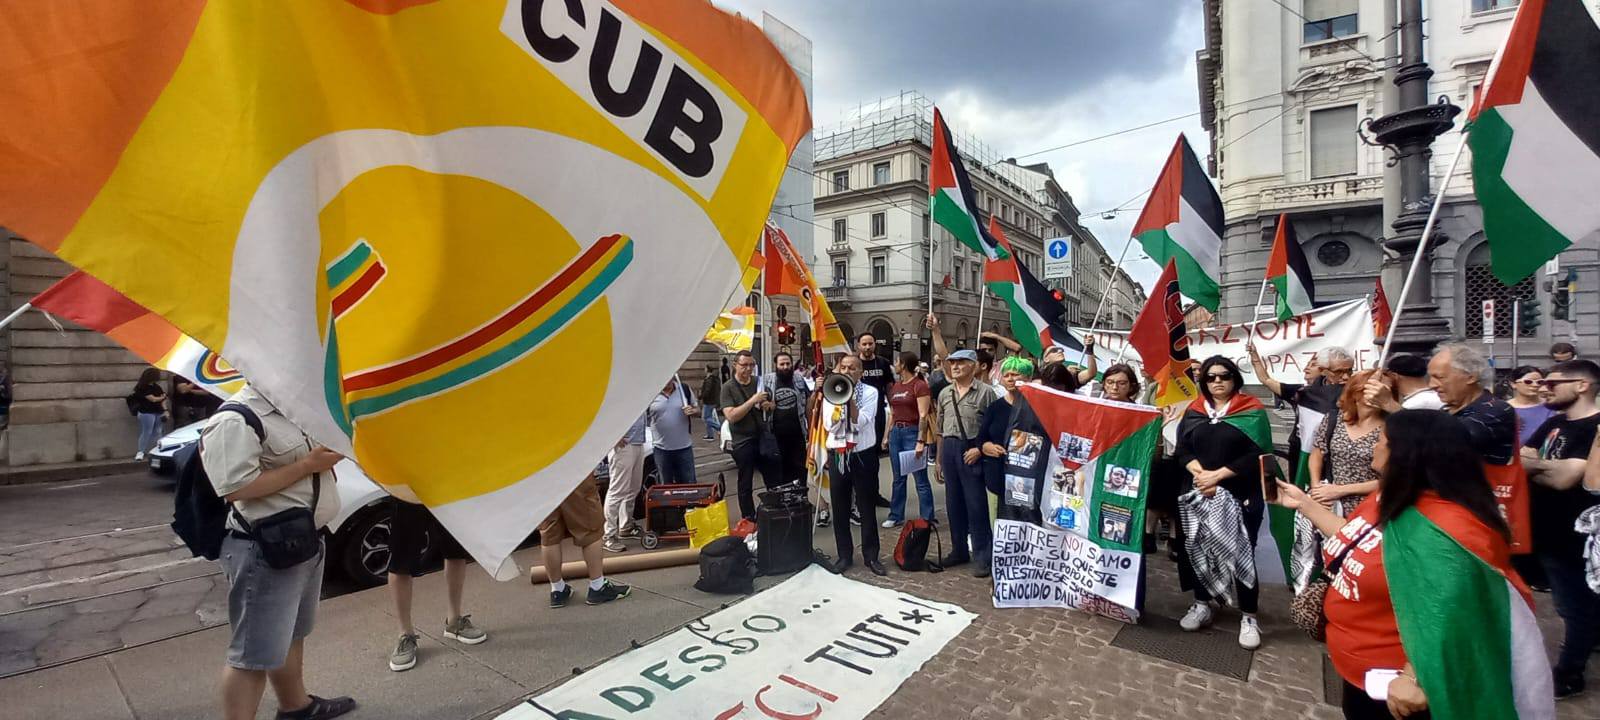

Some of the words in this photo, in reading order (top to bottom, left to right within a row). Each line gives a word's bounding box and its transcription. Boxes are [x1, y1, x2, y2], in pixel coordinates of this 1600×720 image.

[521, 0, 723, 178] CUB
[996, 524, 1058, 548] MENTRE
[1061, 534, 1084, 555] NOI
[994, 567, 1070, 586] PALESTINESE
[1046, 549, 1070, 561] SU
[1073, 557, 1118, 588] QUESTE
[1047, 561, 1058, 571] IL
[1060, 562, 1093, 589] POPOLO
[994, 582, 1051, 602] GENOCIDIO
